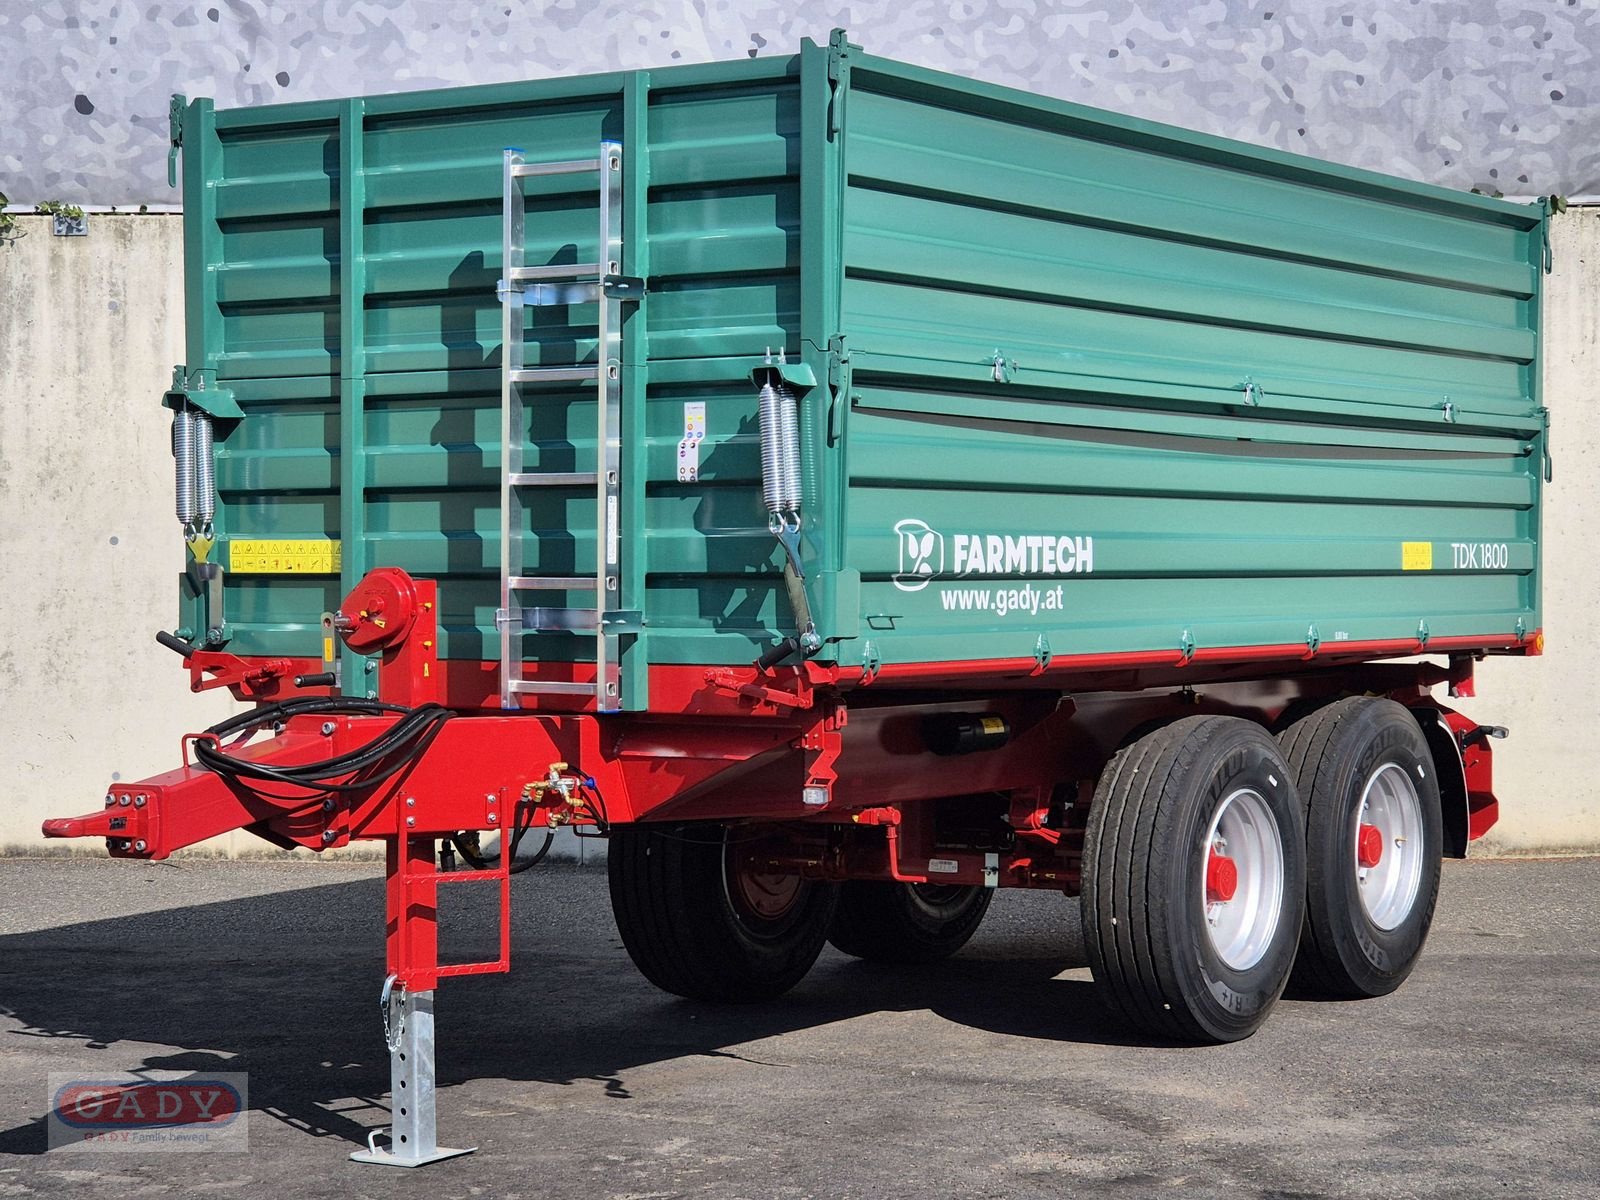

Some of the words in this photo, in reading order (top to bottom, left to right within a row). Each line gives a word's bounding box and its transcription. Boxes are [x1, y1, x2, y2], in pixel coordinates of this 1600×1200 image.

[954, 534, 1094, 574] FARMTECH
[1451, 543, 1479, 569] TDK
[1480, 543, 1508, 569] 1800
[941, 583, 1064, 616] www.gady.at
